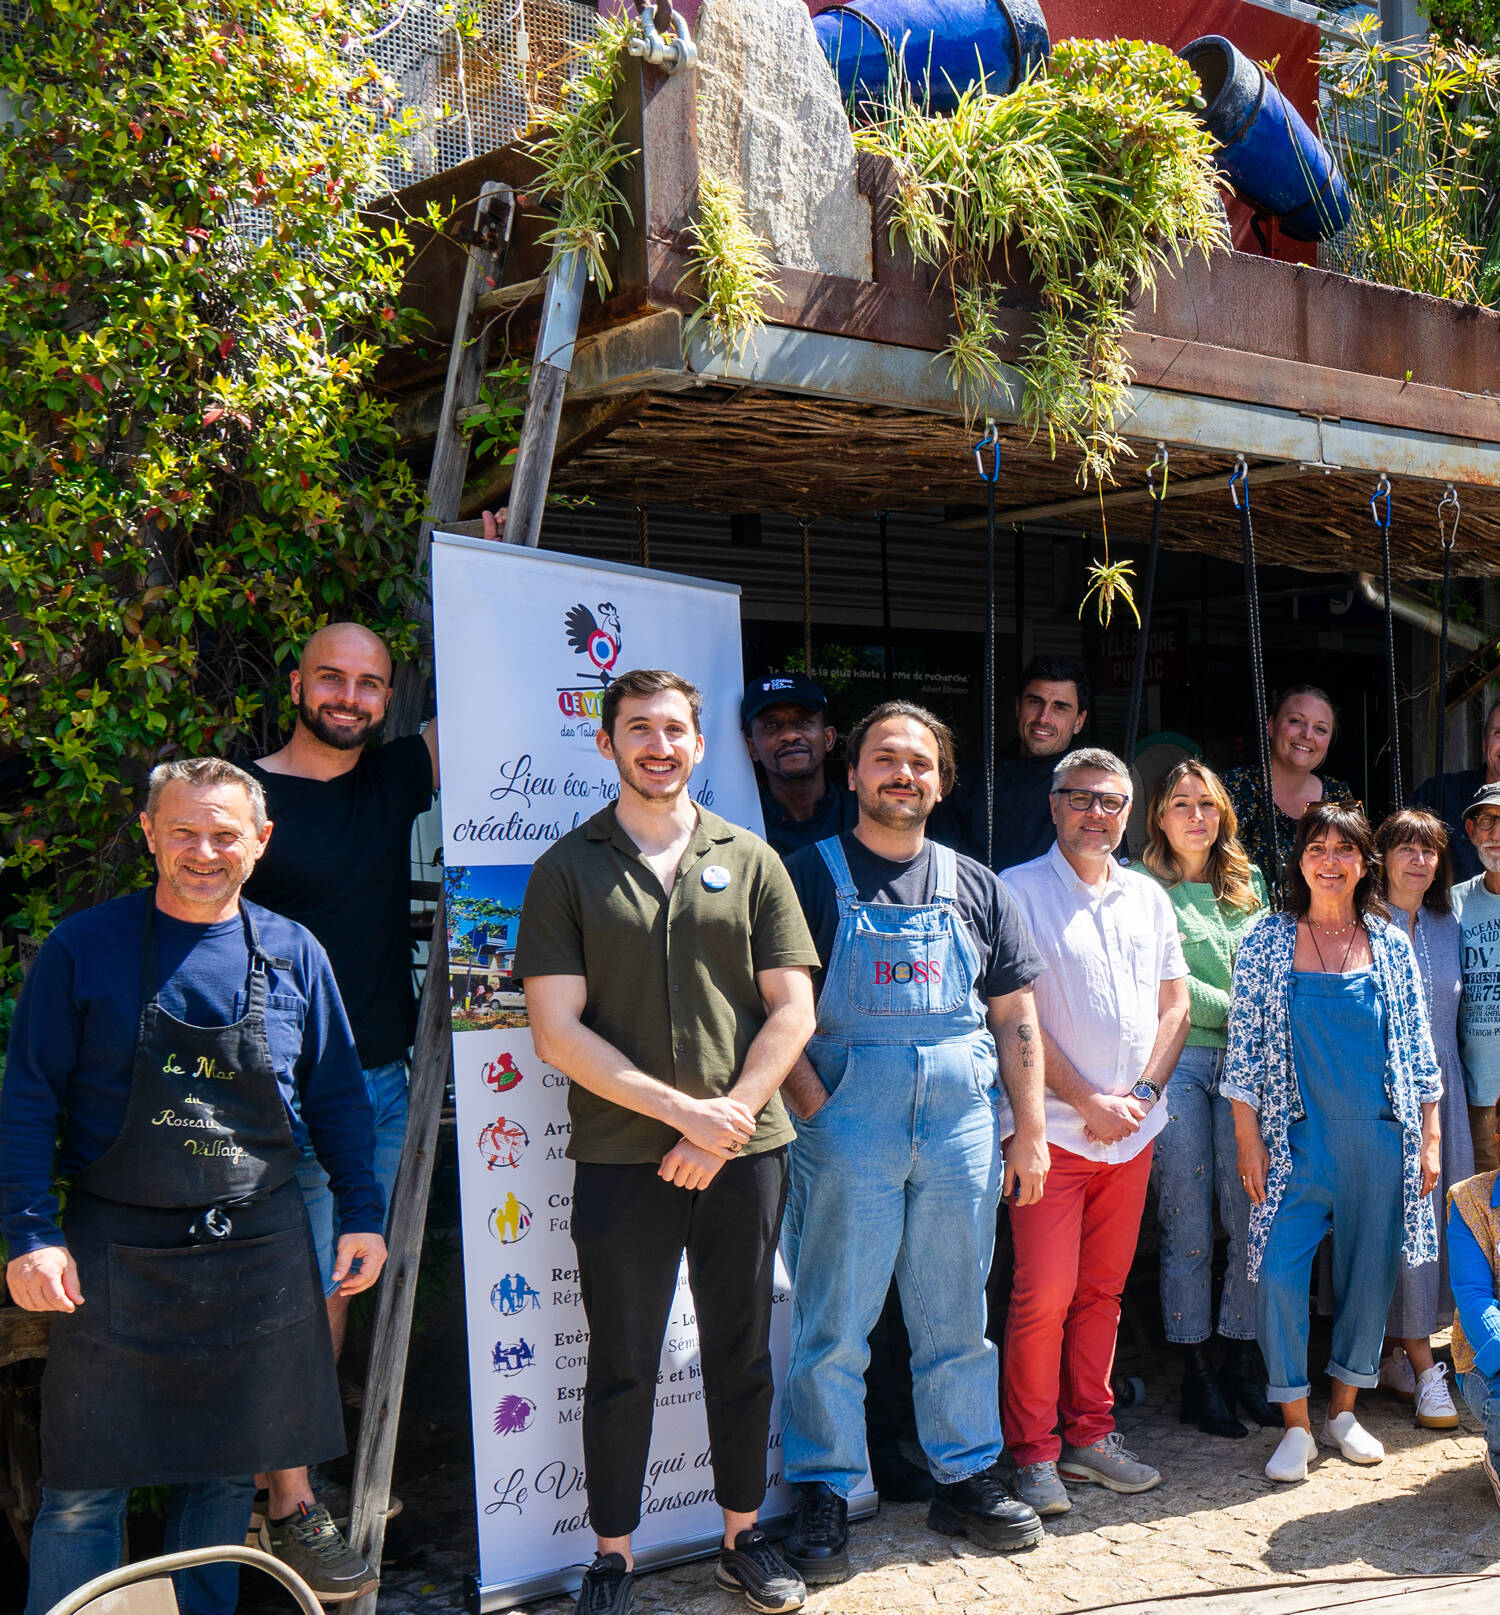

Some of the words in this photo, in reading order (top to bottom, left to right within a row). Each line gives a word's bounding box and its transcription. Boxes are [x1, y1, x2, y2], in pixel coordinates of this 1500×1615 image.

[562, 693, 582, 713] LE
[561, 723, 576, 737] des
[490, 754, 556, 809] Lieu
[696, 778, 715, 807] de
[453, 811, 563, 842] créations
[872, 960, 942, 985] BOSS
[162, 1053, 187, 1076] Le
[184, 1092, 203, 1105] du
[151, 1109, 221, 1131] Roseau
[545, 1146, 565, 1161] At
[549, 1218, 570, 1232] Fa
[771, 1292, 790, 1305] ce.
[682, 1313, 697, 1327] Lo
[669, 1370, 685, 1382] et
[689, 1364, 702, 1379] bi
[558, 1407, 583, 1425] Mé
[484, 1468, 529, 1516] Le
[649, 1450, 687, 1486] qui
